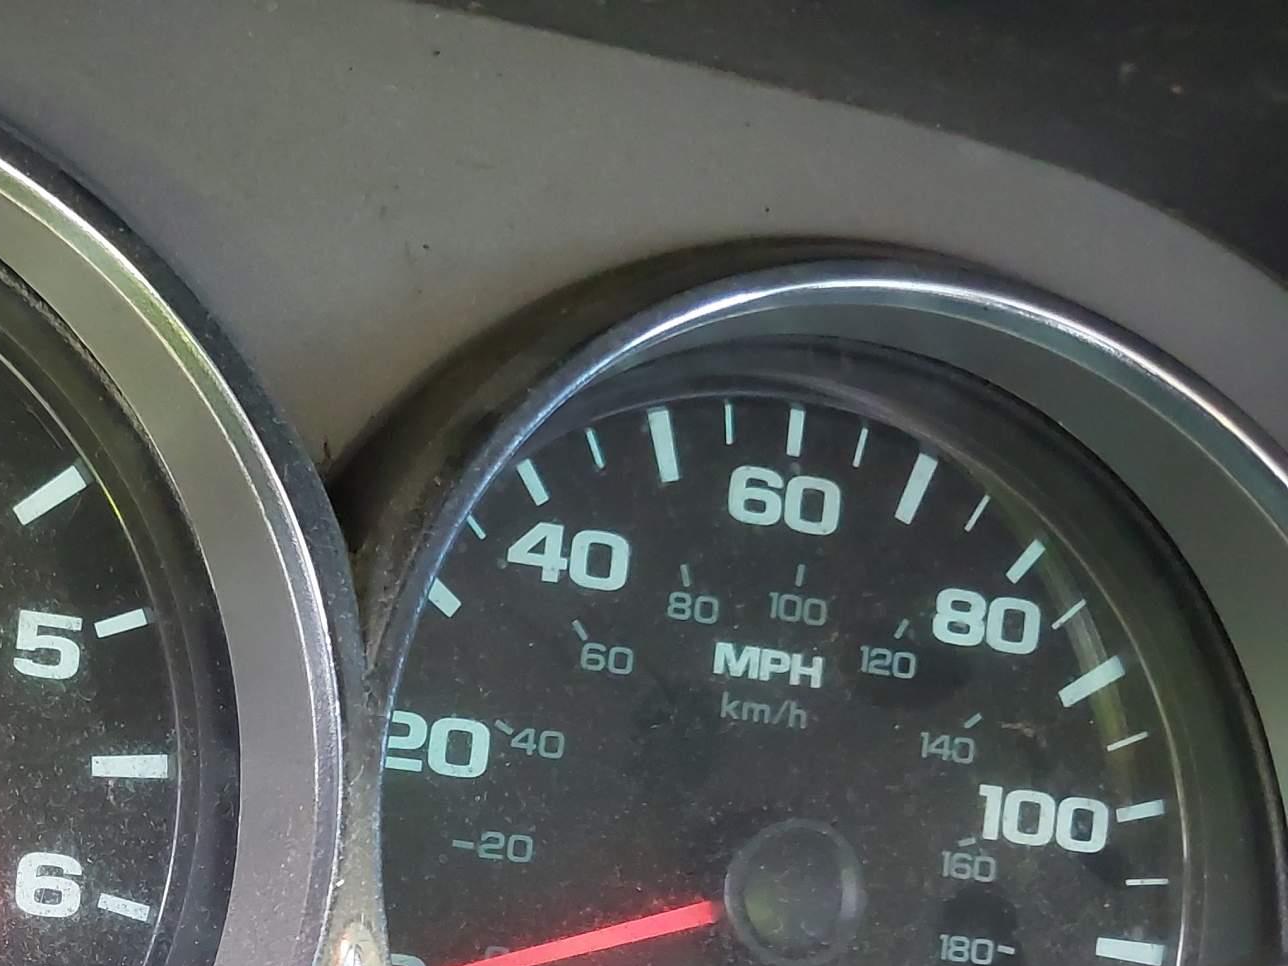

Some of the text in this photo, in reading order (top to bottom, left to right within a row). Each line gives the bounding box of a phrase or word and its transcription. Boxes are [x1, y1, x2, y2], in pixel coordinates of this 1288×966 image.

[727, 465, 842, 536] 60
[507, 521, 631, 591] 40
[667, 591, 719, 625] 80
[768, 591, 828, 627] 100
[932, 588, 1041, 655] 80
[13, 608, 84, 681] 5
[580, 641, 634, 675] 60
[859, 644, 918, 680] 120
[712, 641, 823, 689] MPH
[720, 691, 808, 730] km/h
[385, 711, 490, 778] 20
[511, 727, 565, 760] 40
[920, 731, 975, 765] 140
[978, 784, 1109, 854] 100
[15, 852, 83, 917] 6
[941, 850, 997, 884] 160
[939, 934, 995, 966] 180
